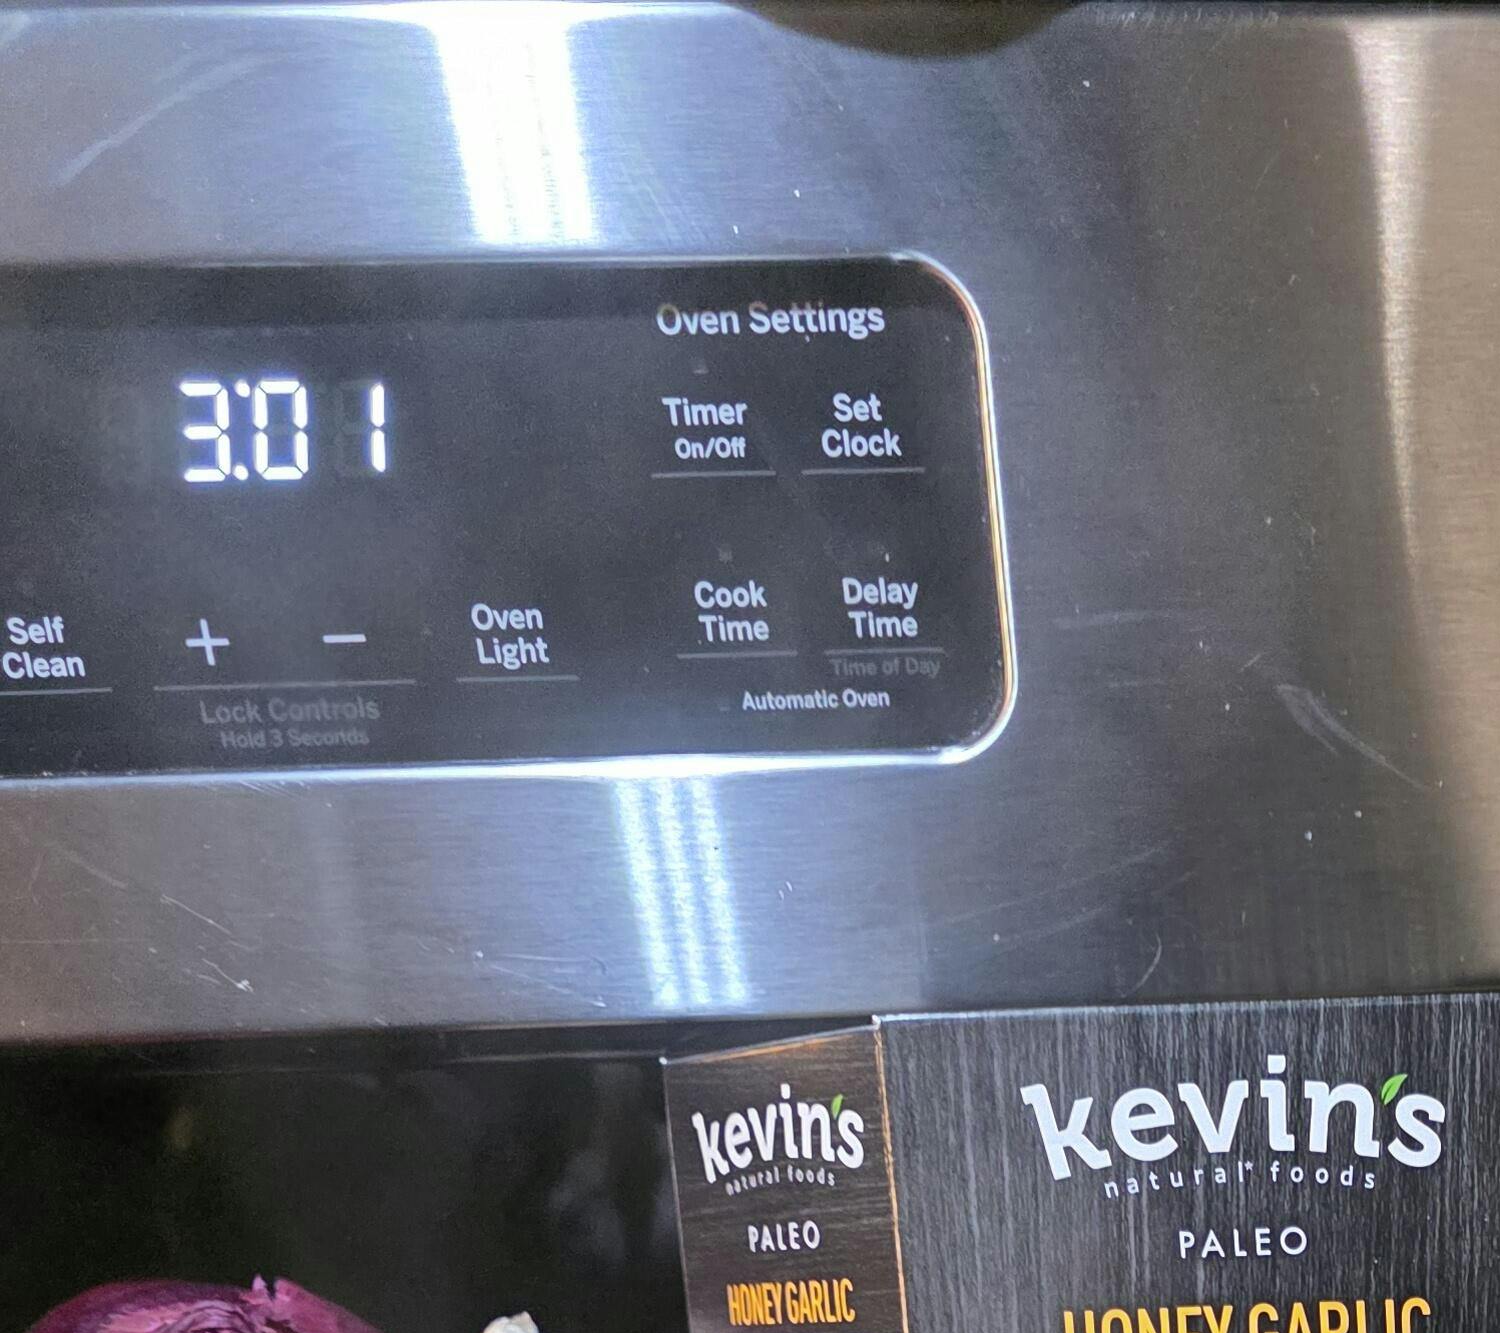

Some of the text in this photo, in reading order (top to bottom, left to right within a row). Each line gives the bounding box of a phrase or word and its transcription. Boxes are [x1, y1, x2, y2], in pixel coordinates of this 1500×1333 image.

[656, 302, 885, 340] Oven Settings
[662, 397, 747, 426] Timer
[832, 392, 882, 422] Set
[674, 436, 746, 459] On/Off
[821, 428, 902, 458] Clock
[694, 580, 768, 608] Cook
[842, 577, 918, 610] Delay
[6, 616, 65, 646] Self
[470, 603, 544, 632] Oven
[698, 614, 770, 642] Time
[848, 611, 918, 639] Time
[2, 650, 86, 680] Clean
[475, 635, 550, 672] Light
[829, 656, 941, 678] Time of Day
[200, 696, 380, 725] Lock Controls
[742, 689, 890, 711] Automatic Oven
[220, 727, 370, 750] Hold 3 Seconds
[1019, 1054, 1446, 1181] kevin's
[691, 1083, 864, 1184] kevin's
[787, 1164, 835, 1187] foods
[1271, 1160, 1375, 1189] foods
[747, 1219, 820, 1253] PALEO
[1178, 1226, 1308, 1259] PALEO
[726, 1277, 856, 1326] HONEY GARLIC
